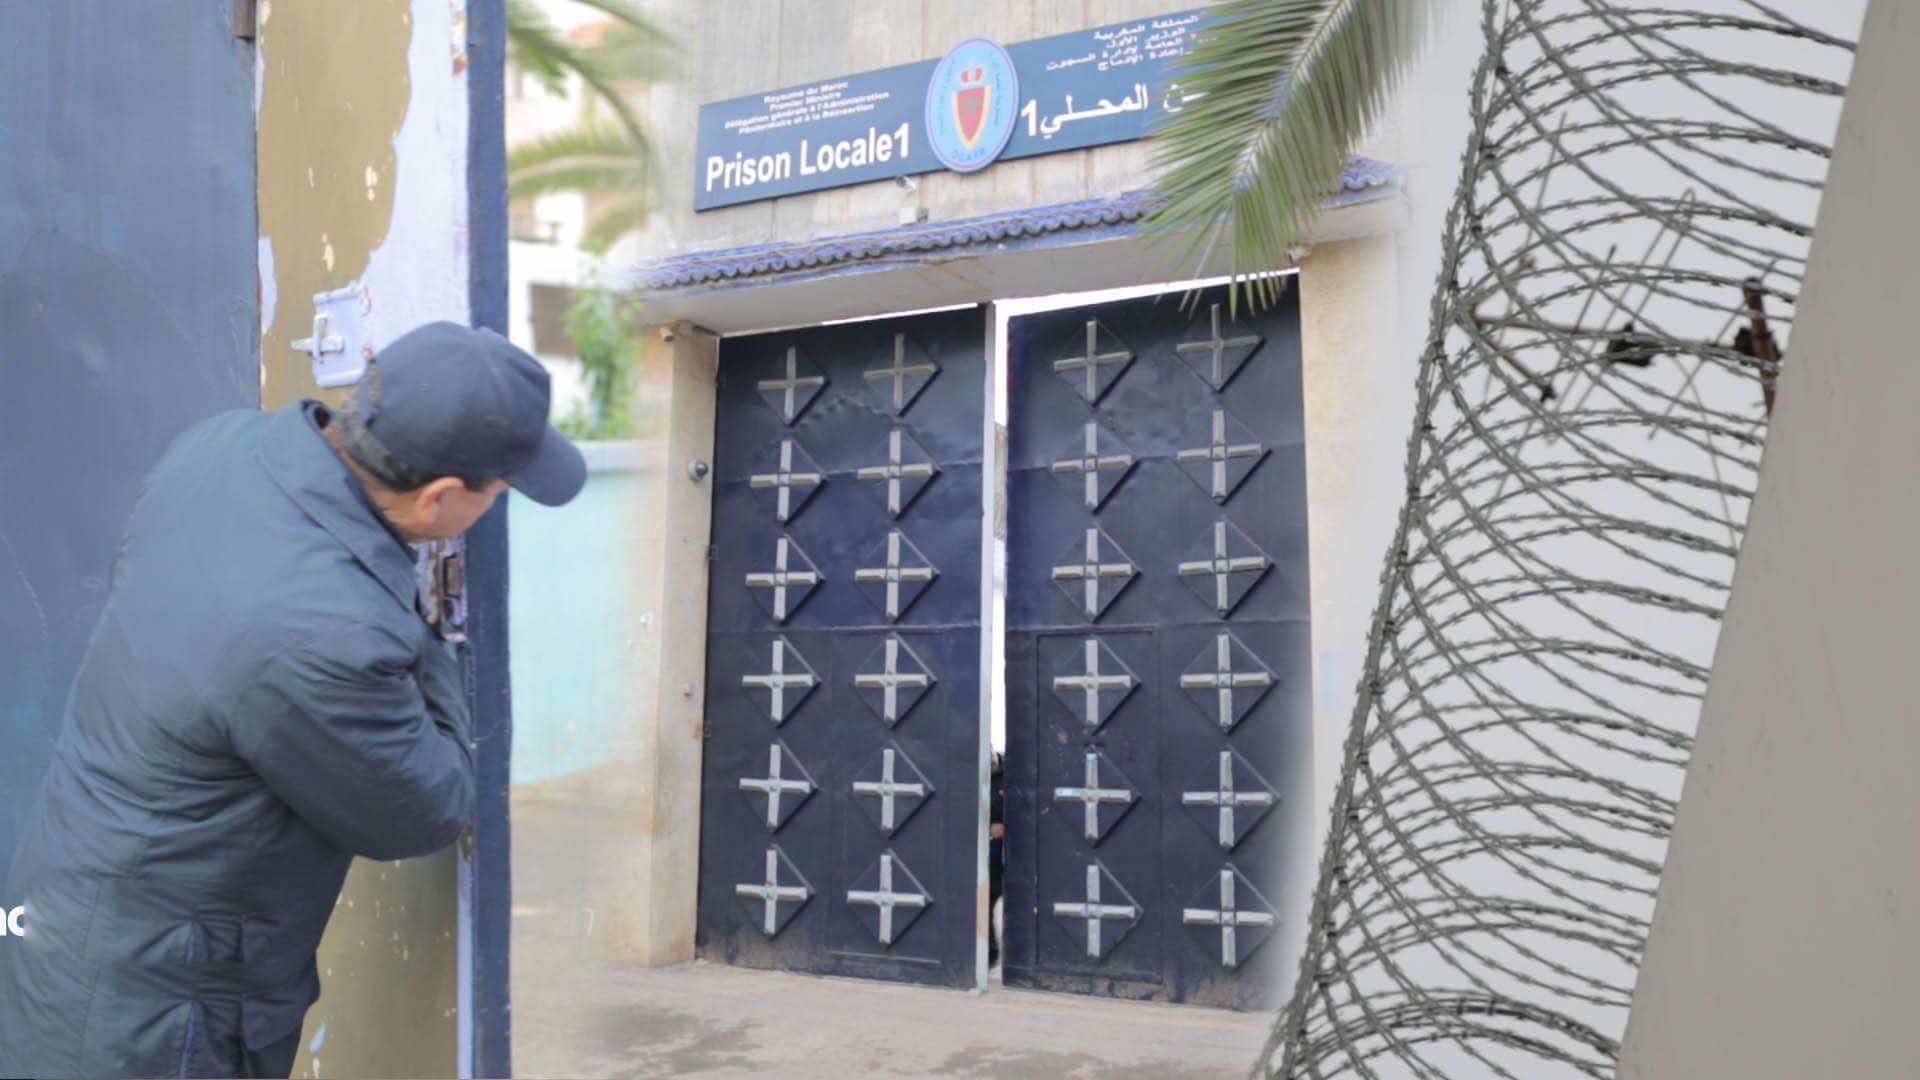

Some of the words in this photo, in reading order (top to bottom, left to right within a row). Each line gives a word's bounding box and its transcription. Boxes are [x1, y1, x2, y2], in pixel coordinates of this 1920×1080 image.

[763, 90, 805, 105] Royaume
[806, 87, 819, 97] du
[820, 81, 849, 94] Maroc
[769, 99, 804, 112] Premier
[805, 91, 842, 105] Ministre
[705, 151, 792, 192] Prison
